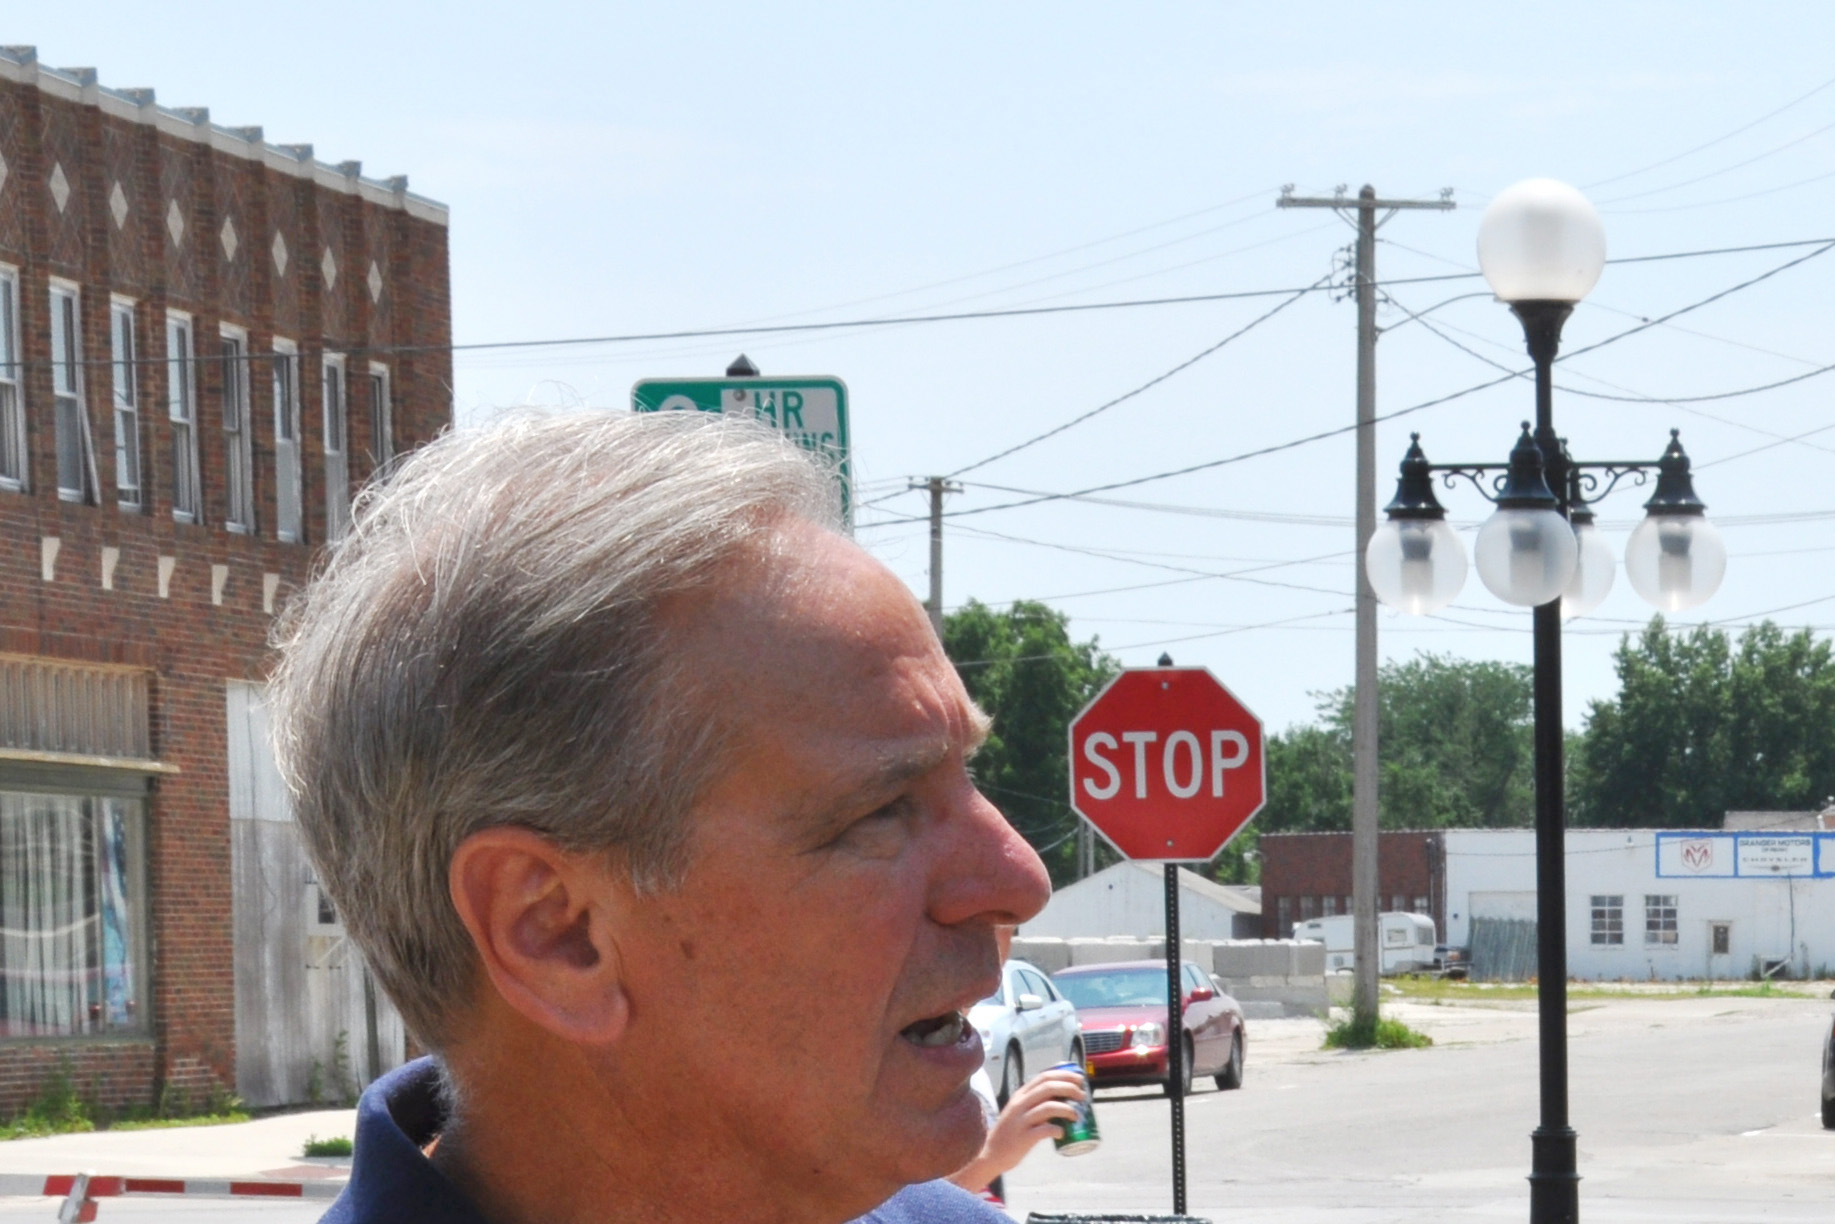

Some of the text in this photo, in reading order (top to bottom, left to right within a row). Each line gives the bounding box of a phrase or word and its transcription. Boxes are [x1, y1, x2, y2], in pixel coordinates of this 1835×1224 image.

[754, 391, 804, 428] HR
[1083, 729, 1249, 800] STOP
[1777, 838, 1811, 847] MOTORS
